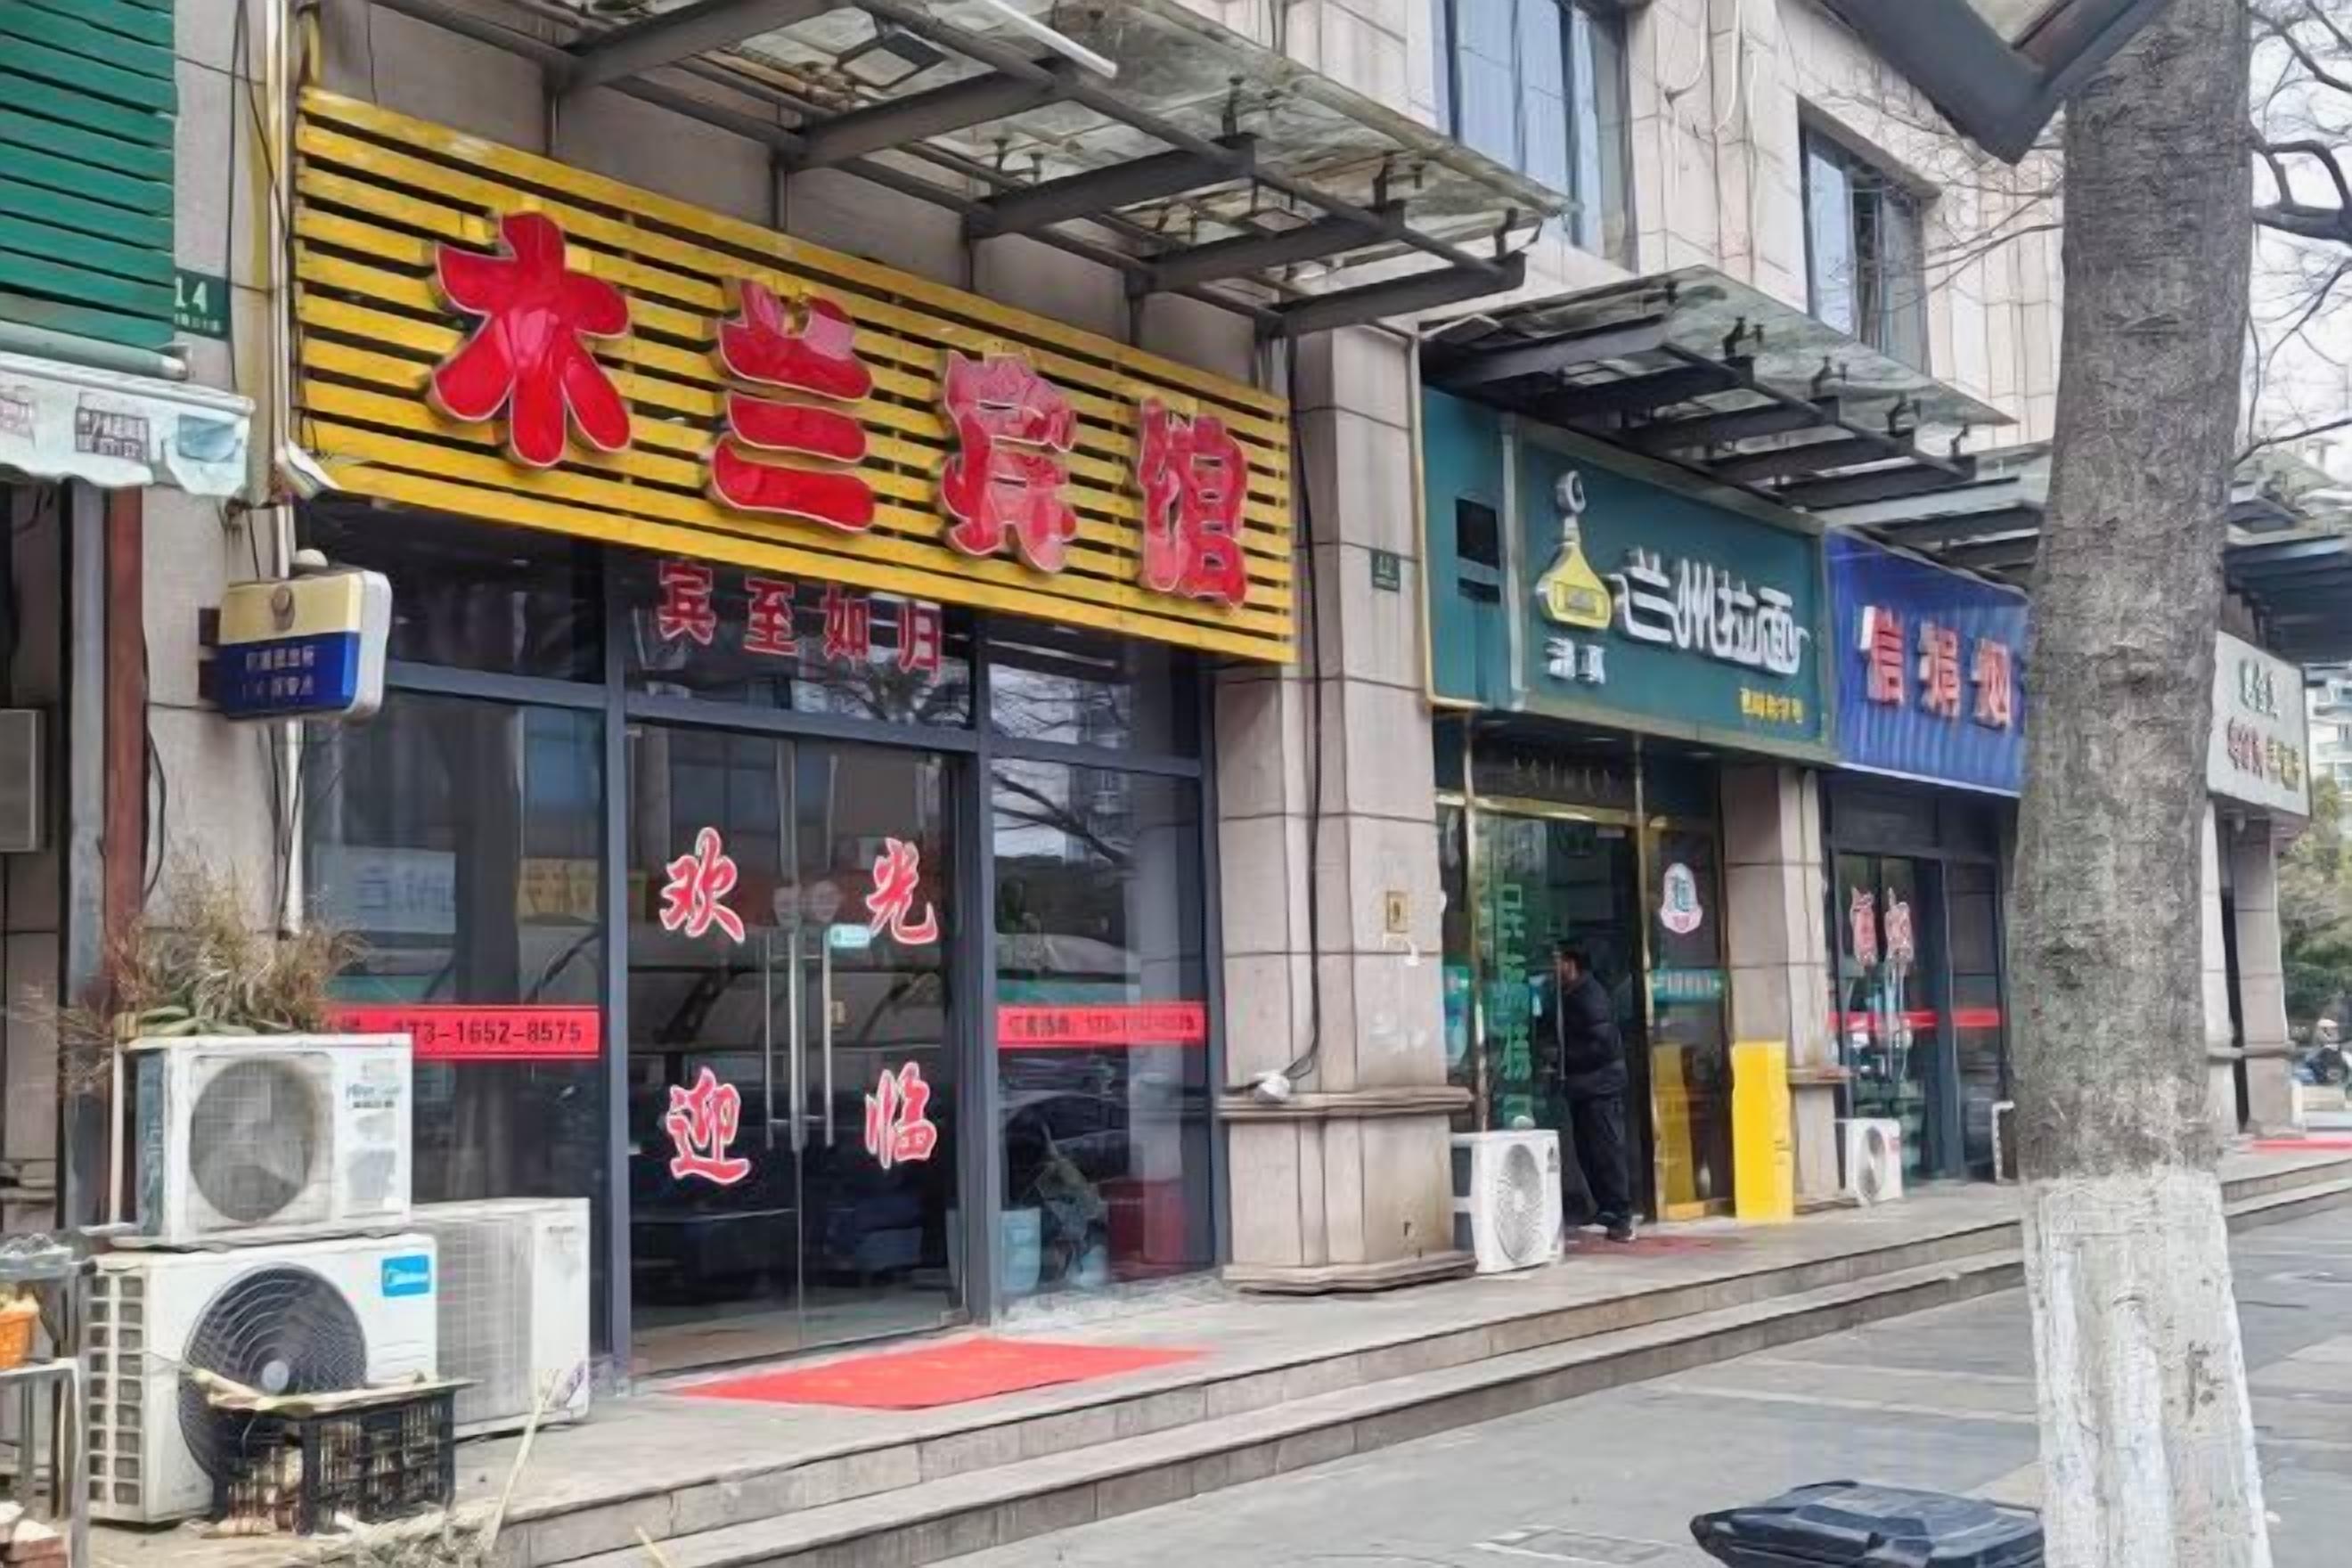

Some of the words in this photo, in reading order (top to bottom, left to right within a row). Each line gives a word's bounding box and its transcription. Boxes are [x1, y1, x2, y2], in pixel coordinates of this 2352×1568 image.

[431, 211, 1245, 608] 木兰宾馆
[657, 559, 942, 684] 宾至如归
[1607, 546, 1809, 674] 兰州拉面
[659, 827, 751, 1185] 欢迎
[865, 837, 938, 1169] 光临
